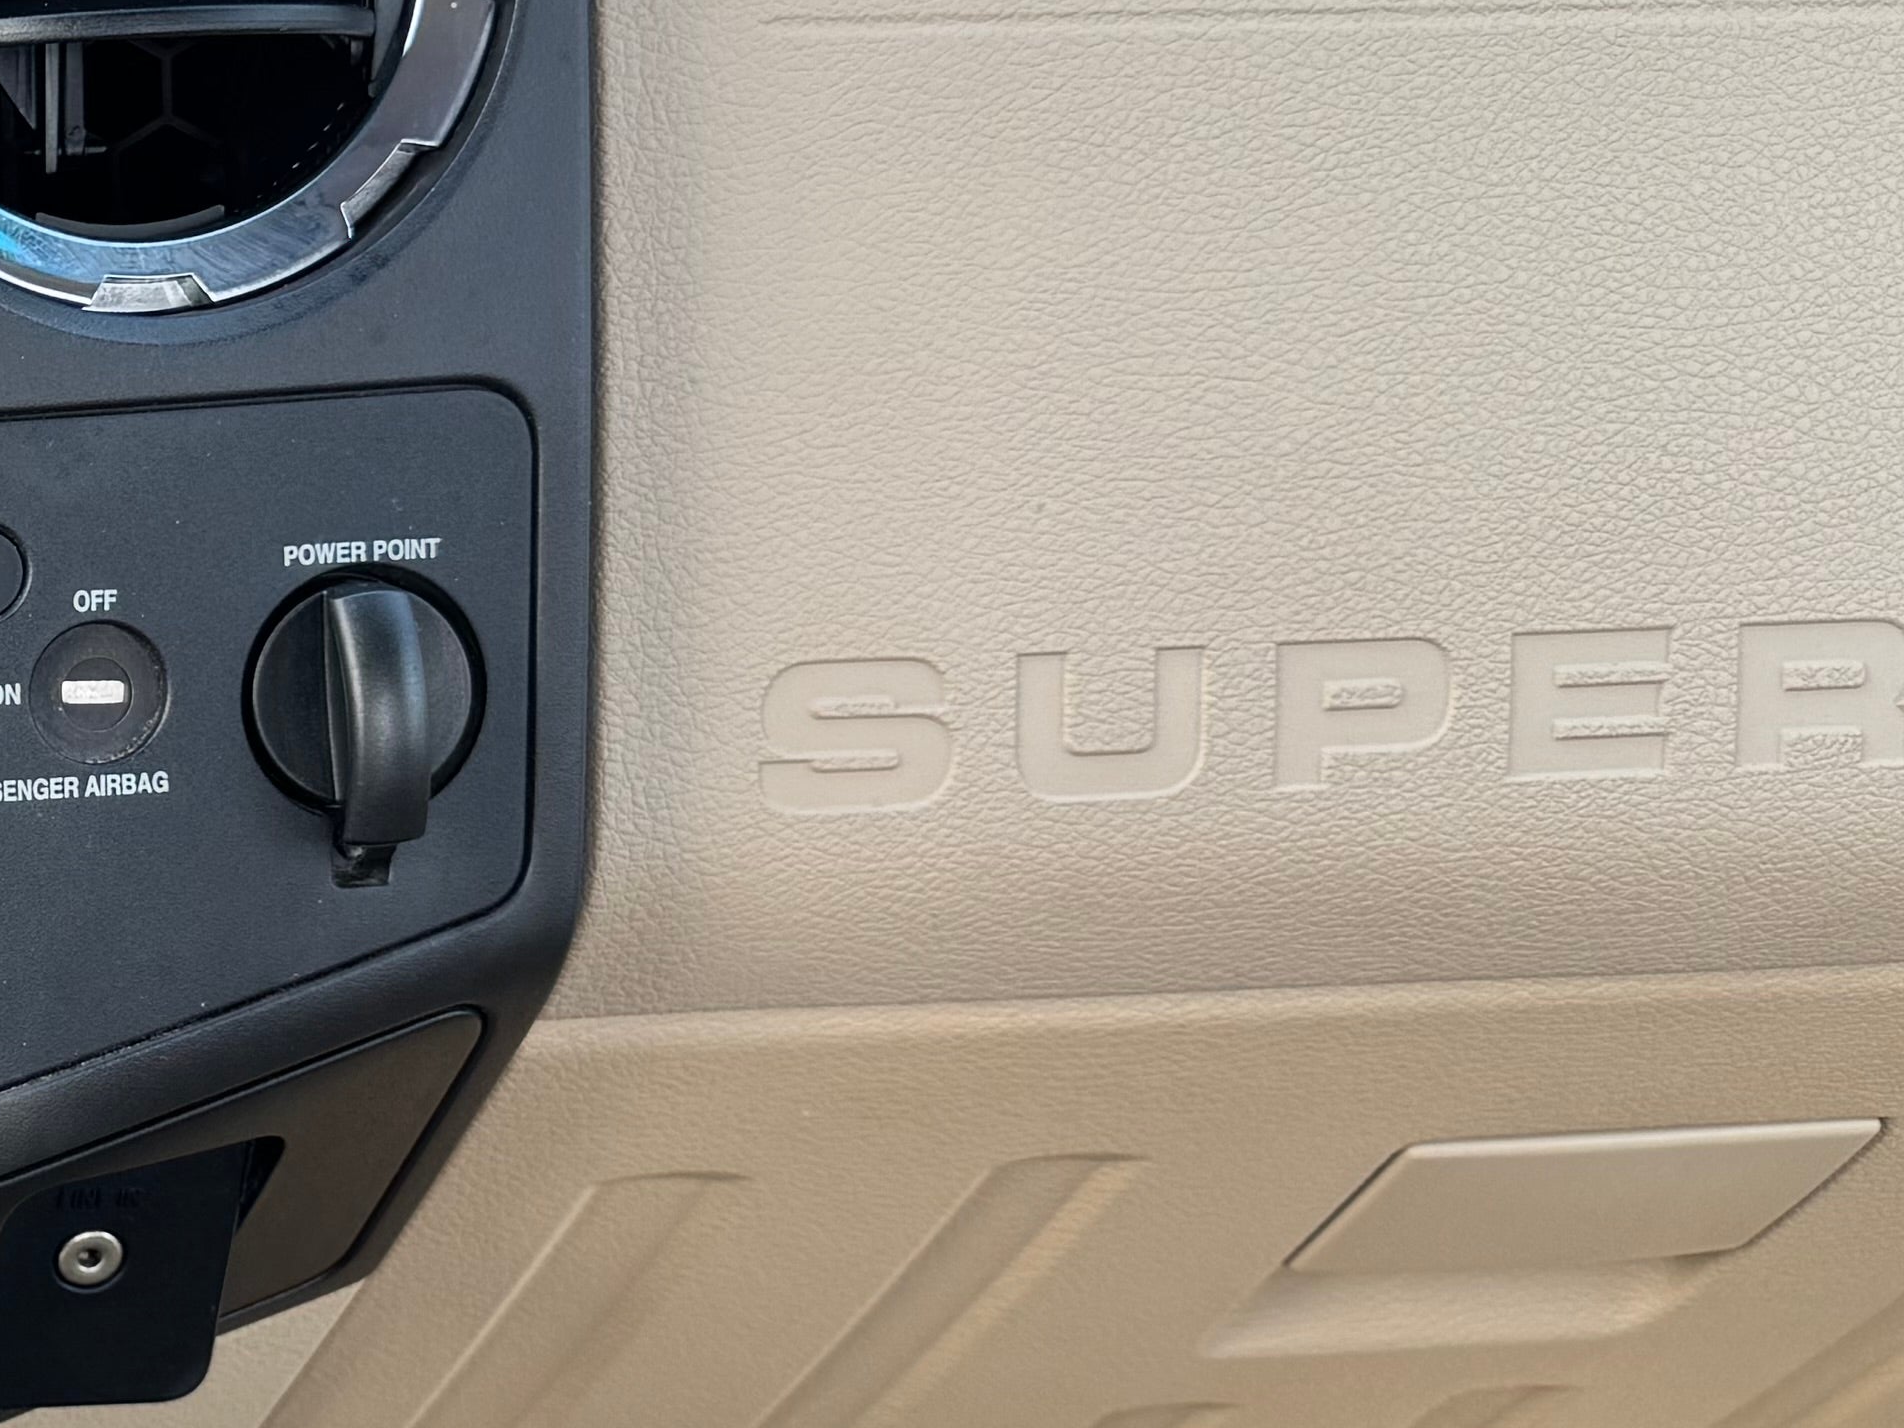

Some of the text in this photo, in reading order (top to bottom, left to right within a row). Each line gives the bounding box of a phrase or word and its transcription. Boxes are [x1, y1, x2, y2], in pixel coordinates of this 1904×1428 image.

[283, 537, 443, 567] POWER POINT
[72, 588, 118, 613] OFF
[756, 617, 1904, 813] SUPER
[84, 770, 170, 798] AIRBAG
